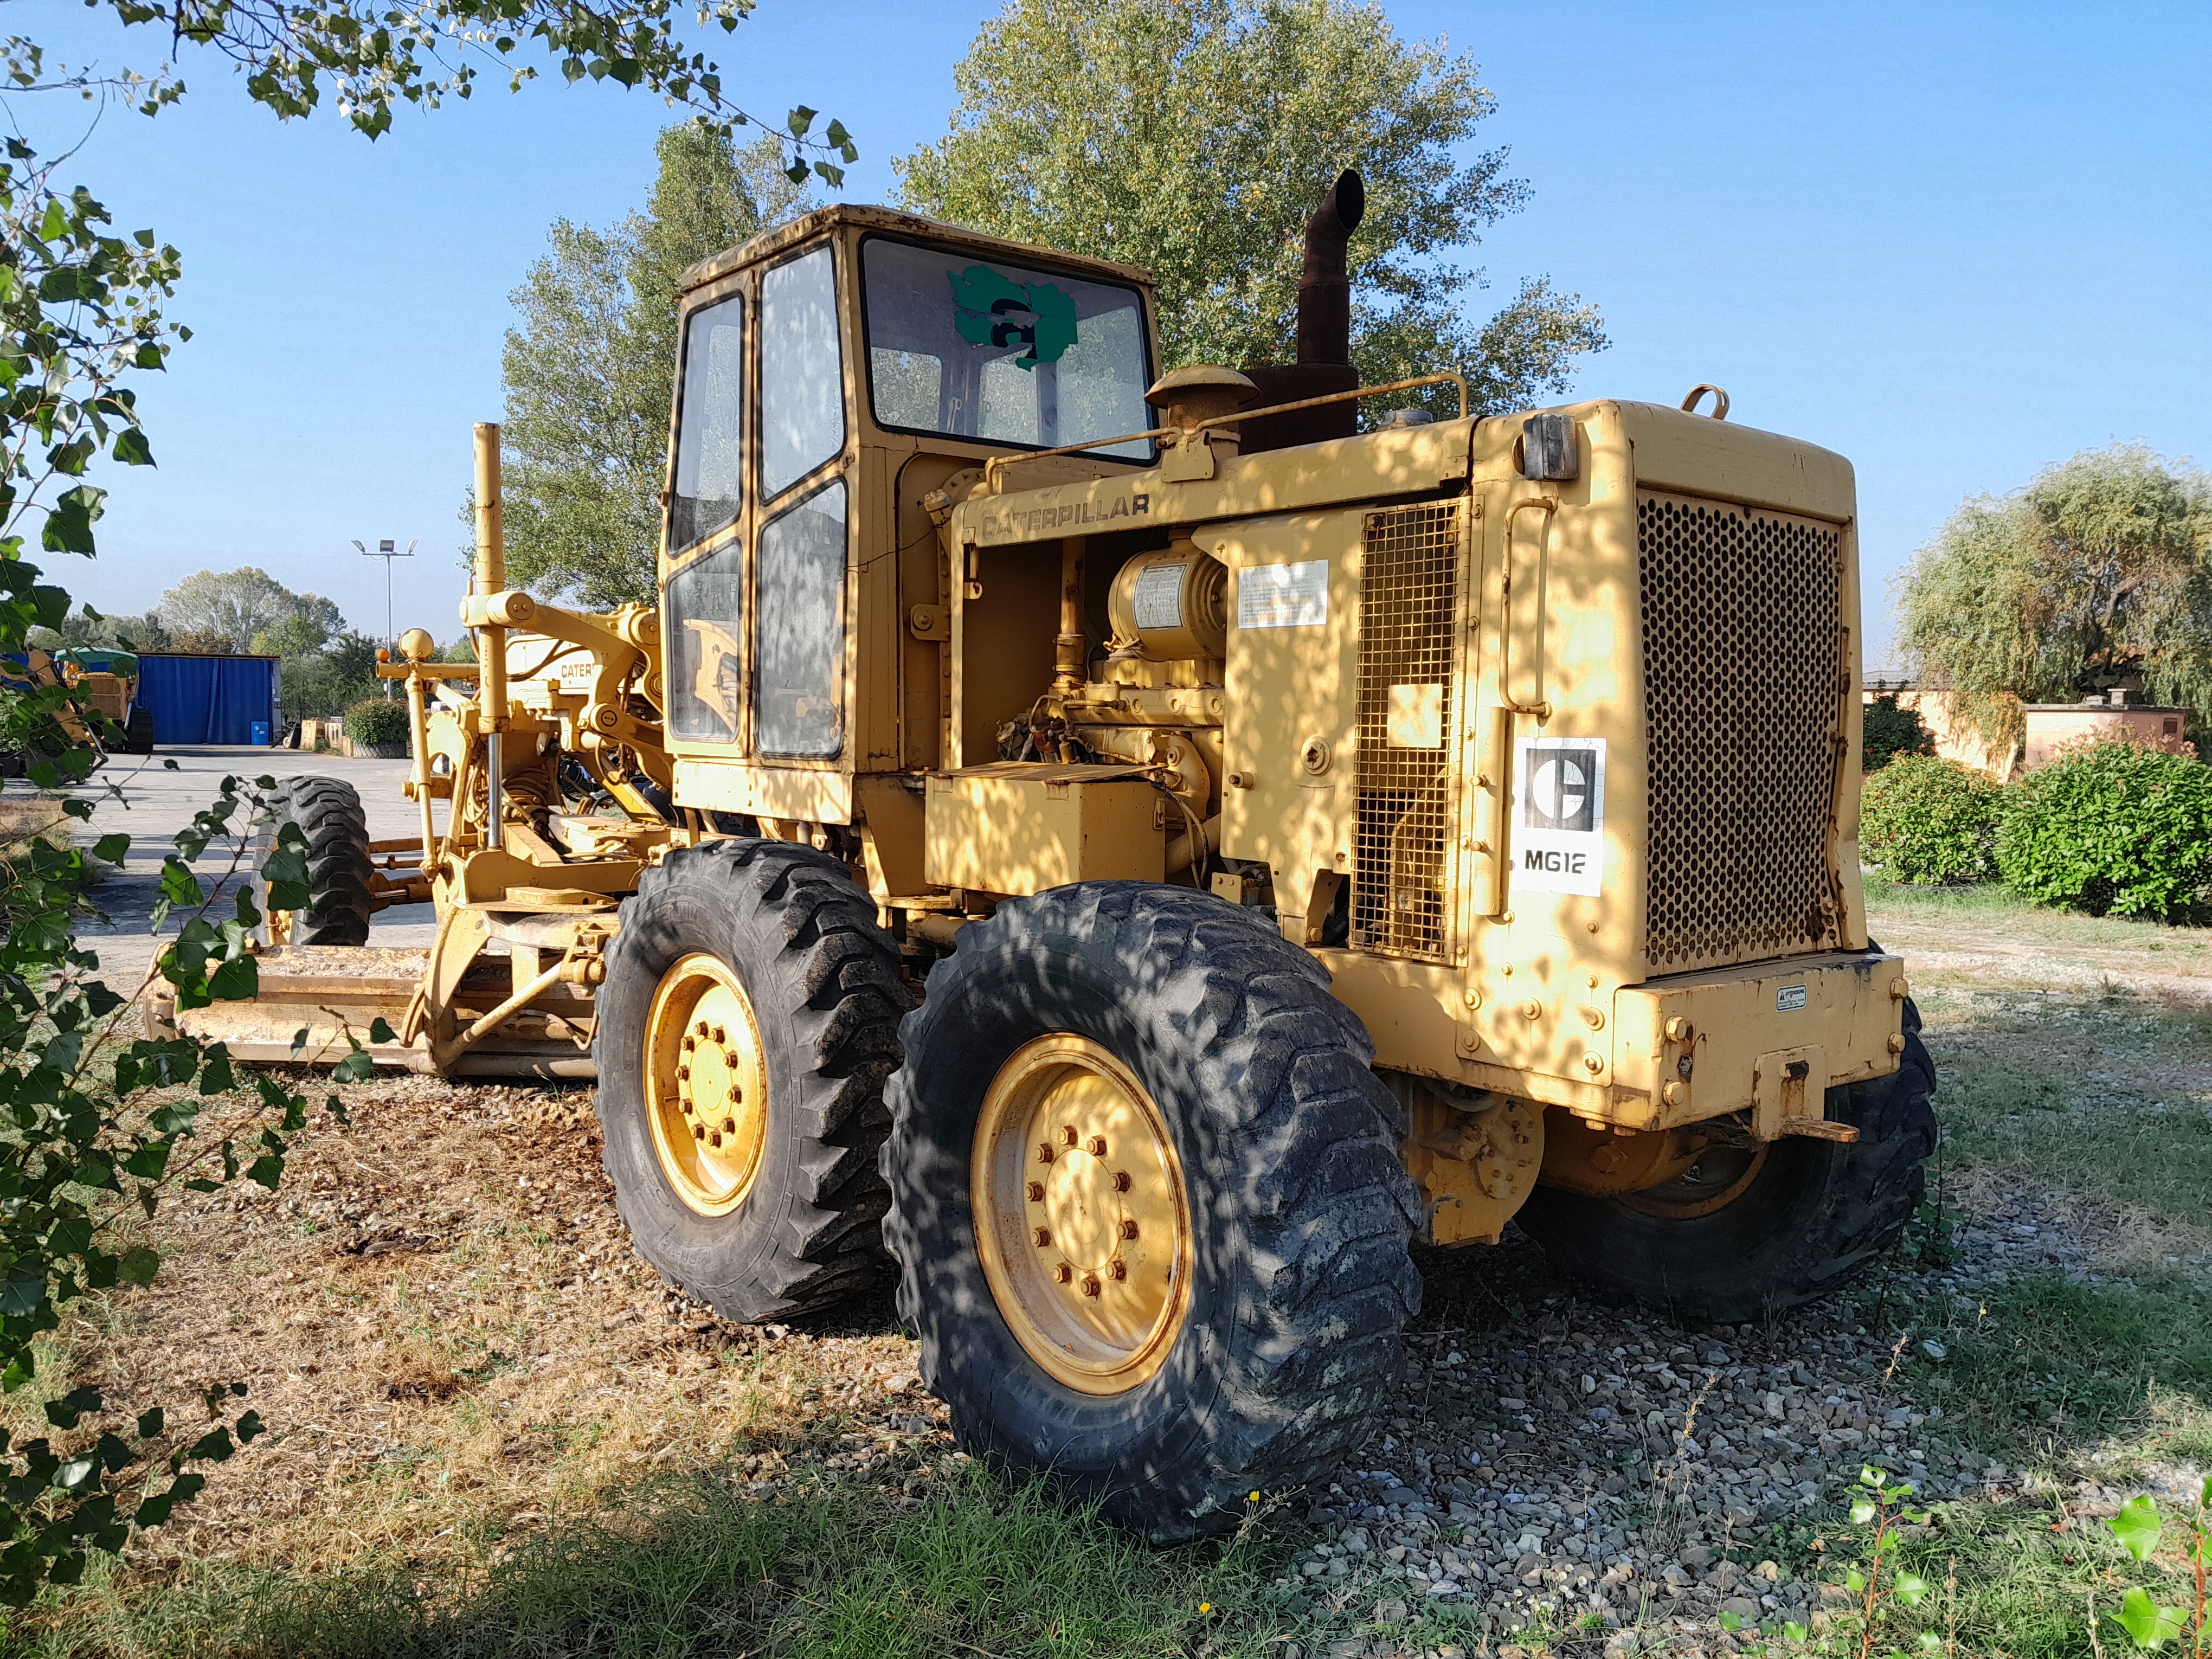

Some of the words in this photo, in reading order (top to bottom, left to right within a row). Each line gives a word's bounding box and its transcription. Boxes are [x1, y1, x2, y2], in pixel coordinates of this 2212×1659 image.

[982, 494, 1149, 540] CATERPILLAR
[562, 663, 594, 678] CATER
[1525, 850, 1586, 874] MG12
